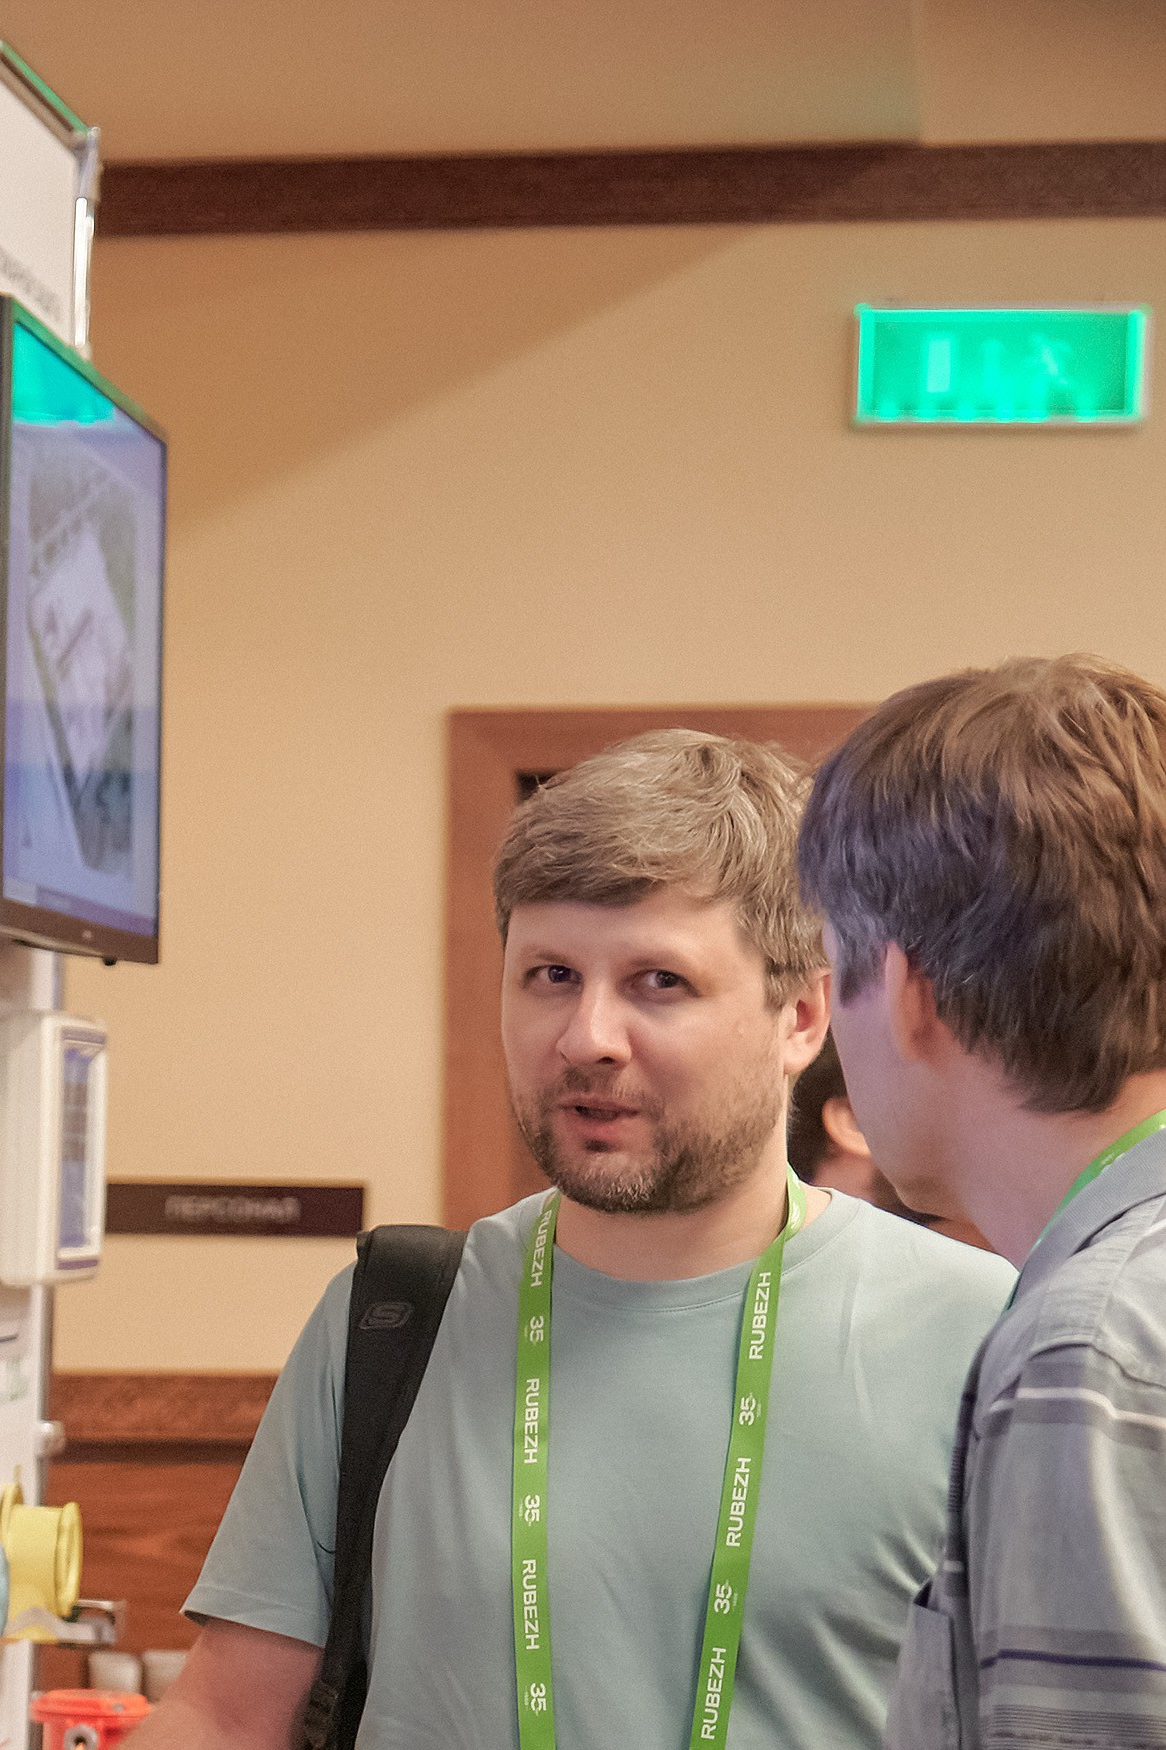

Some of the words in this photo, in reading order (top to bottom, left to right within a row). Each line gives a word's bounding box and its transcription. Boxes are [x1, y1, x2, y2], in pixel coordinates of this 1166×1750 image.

[530, 1209, 553, 1288] RUBEZH
[529, 1315, 545, 1343] 35
[748, 1271, 773, 1361] RUBEZH
[523, 1377, 540, 1464] RUBEZH
[738, 1395, 756, 1427] 35
[524, 1494, 540, 1524] 35
[725, 1456, 752, 1548] RUBEZH
[522, 1559, 540, 1651] RUBEZH
[713, 1583, 733, 1615] 35
[530, 1682, 547, 1712] 35
[700, 1646, 727, 1741] RUBEZH
